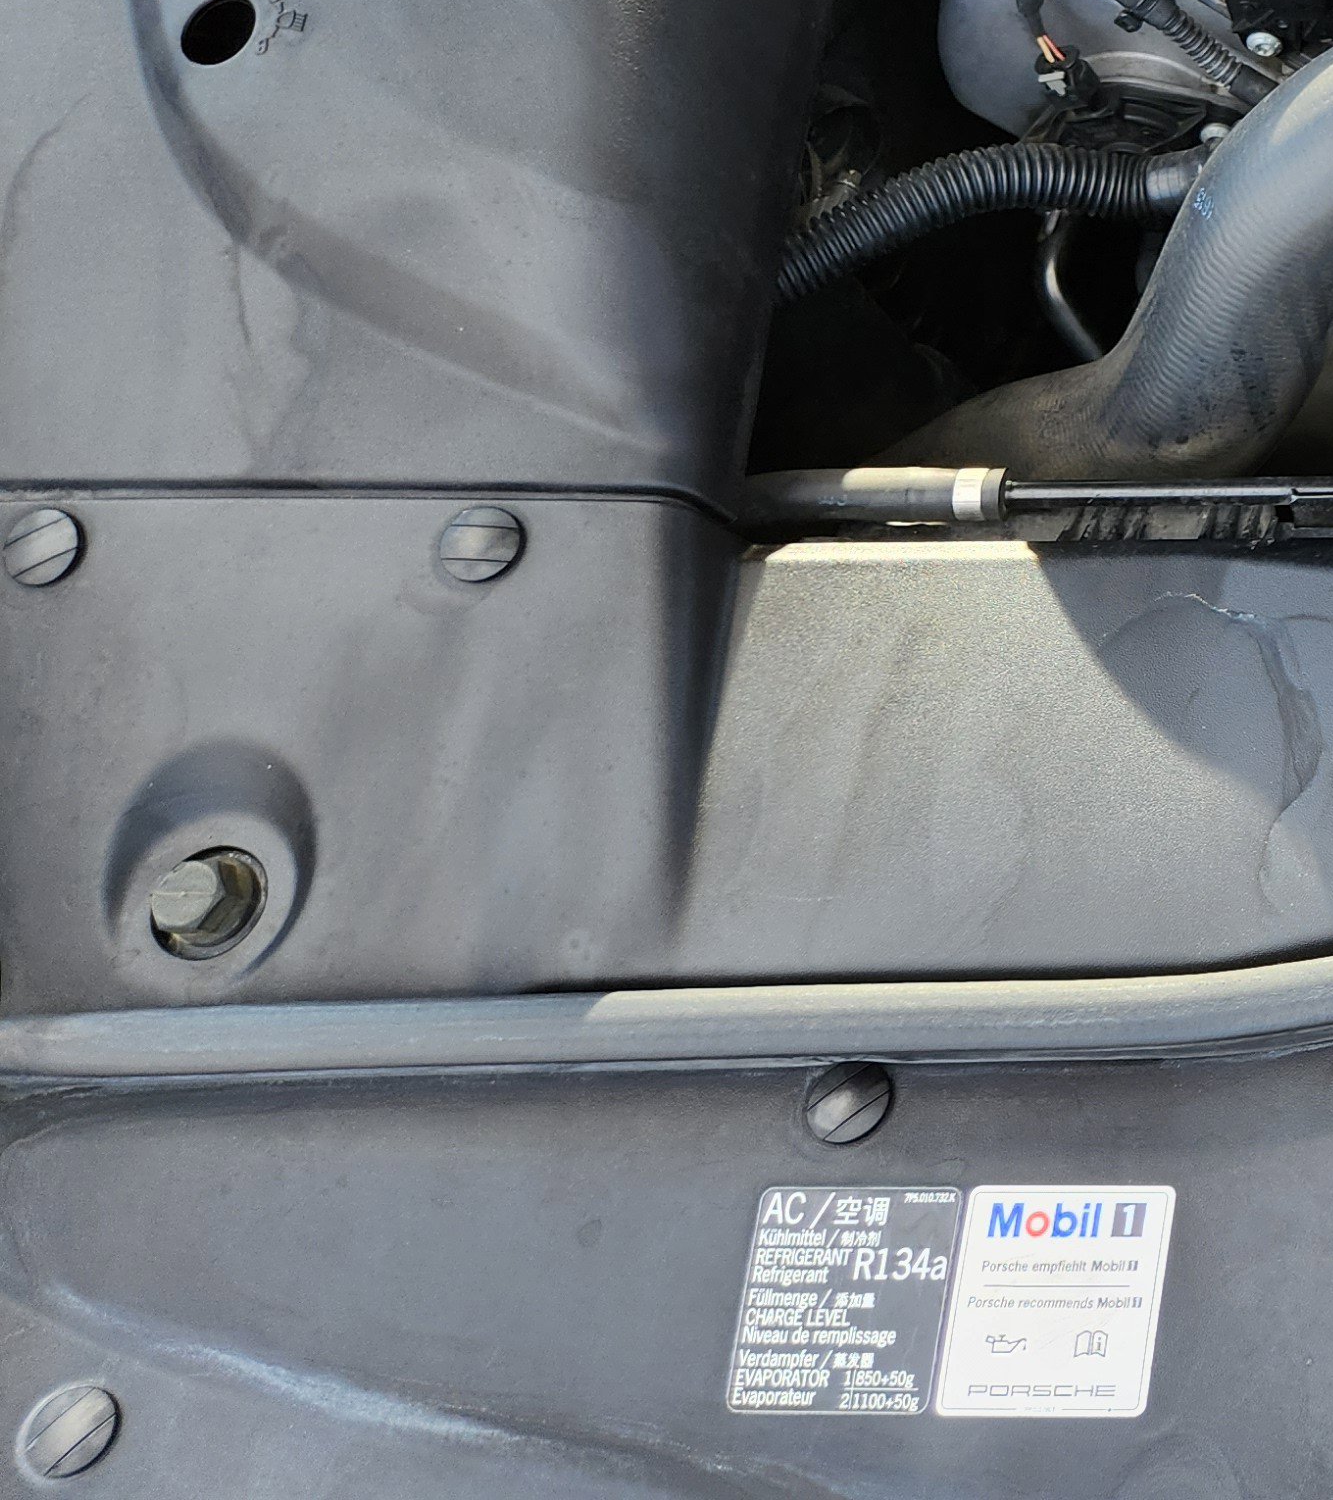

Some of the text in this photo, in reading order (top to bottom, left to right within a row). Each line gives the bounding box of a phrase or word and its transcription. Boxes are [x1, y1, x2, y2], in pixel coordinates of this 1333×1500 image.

[762, 1191, 807, 1224] AC
[833, 1196, 891, 1226] 空调
[986, 1203, 1102, 1238] Mobil
[758, 1229, 826, 1246] Kühlmittel
[755, 1247, 948, 1281] REFRIGERANT R134a
[981, 1260, 1028, 1272] Porsche
[1032, 1260, 1086, 1274] empfiehlt
[752, 1266, 829, 1286] Refrigerant
[747, 1288, 818, 1309] Füllmenge
[967, 1296, 1014, 1308] Porsche
[1018, 1296, 1093, 1309] recommends
[745, 1308, 850, 1327] CHARGE LEVEL
[741, 1327, 897, 1348] Niveau de remplissage
[739, 1349, 819, 1369] Verdampfer
[735, 1369, 830, 1388] EVAPORATOR
[855, 1370, 916, 1388] 850+50g
[732, 1388, 816, 1410] Evaporateur
[839, 1394, 849, 1410] 2
[967, 1385, 1116, 1397] PORSCHE
